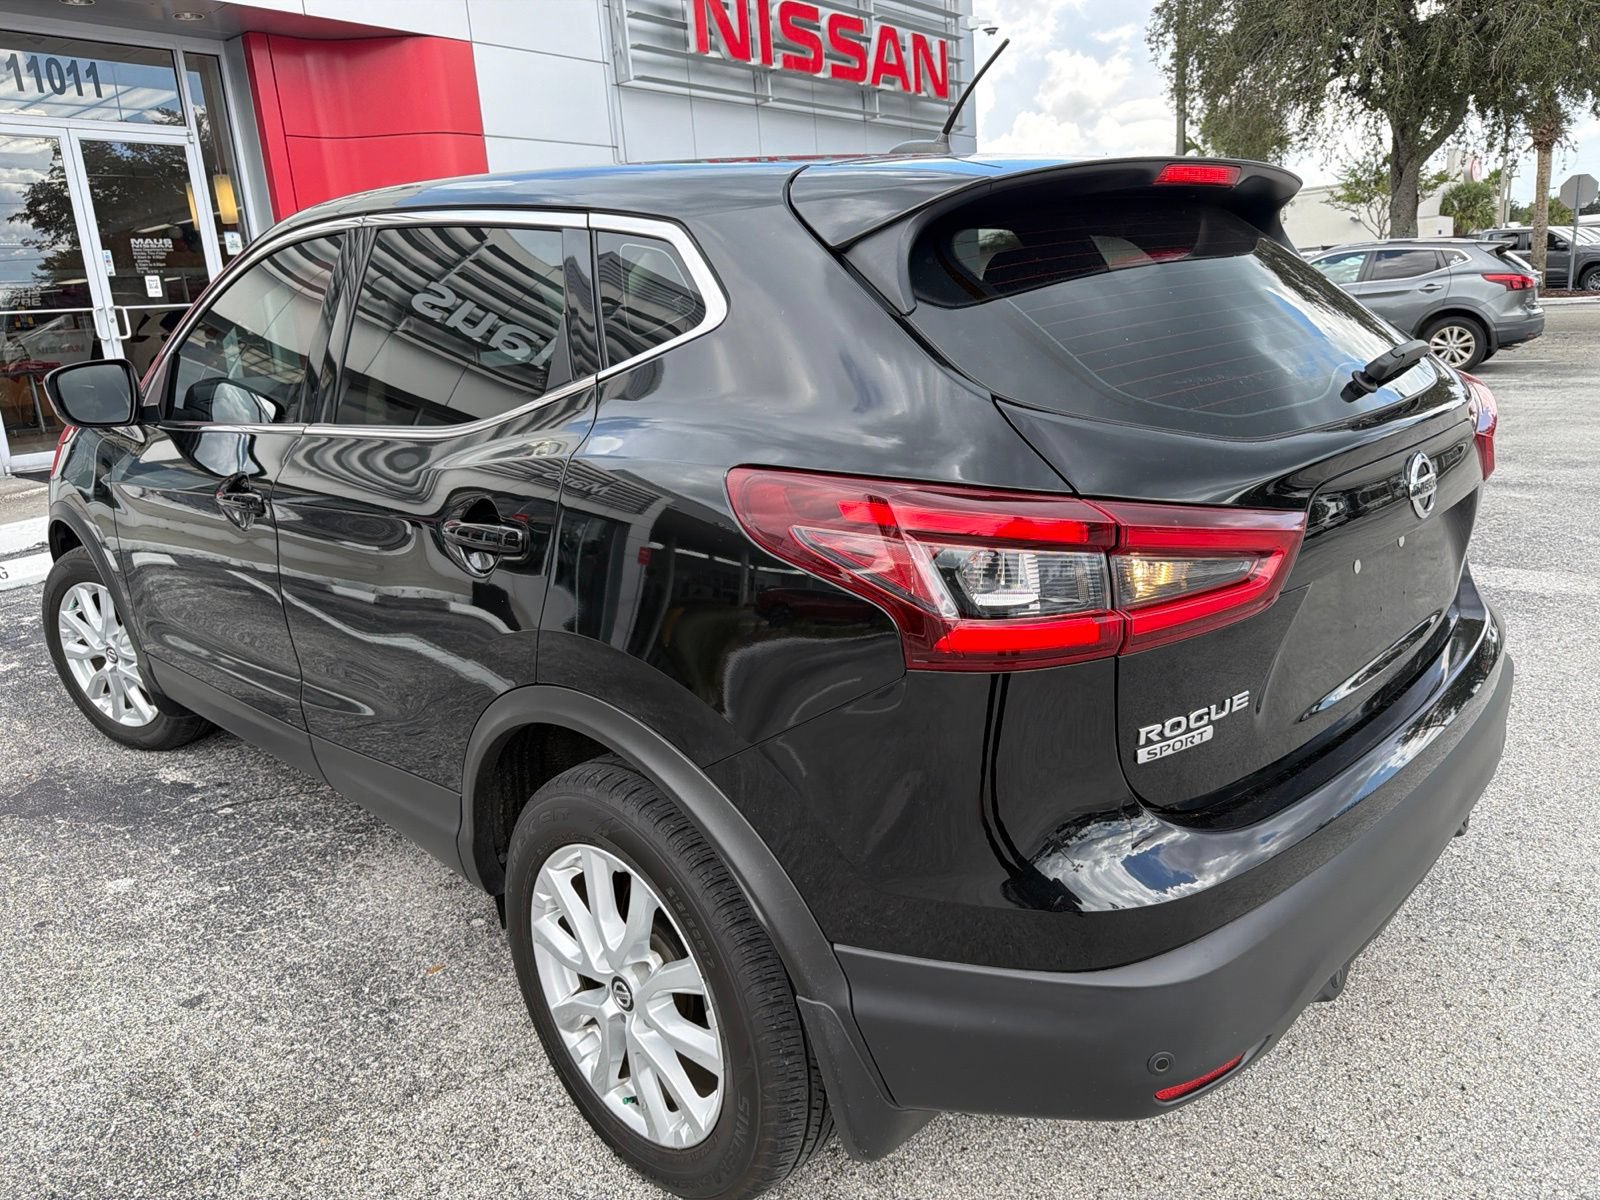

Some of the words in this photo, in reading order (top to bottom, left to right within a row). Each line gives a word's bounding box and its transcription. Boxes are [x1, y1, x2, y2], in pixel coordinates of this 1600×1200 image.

[692, 0, 950, 100] NISSAN
[5, 53, 103, 98] 11011
[1138, 690, 1250, 746] ROGUE
[1146, 729, 1208, 761] SPORT
